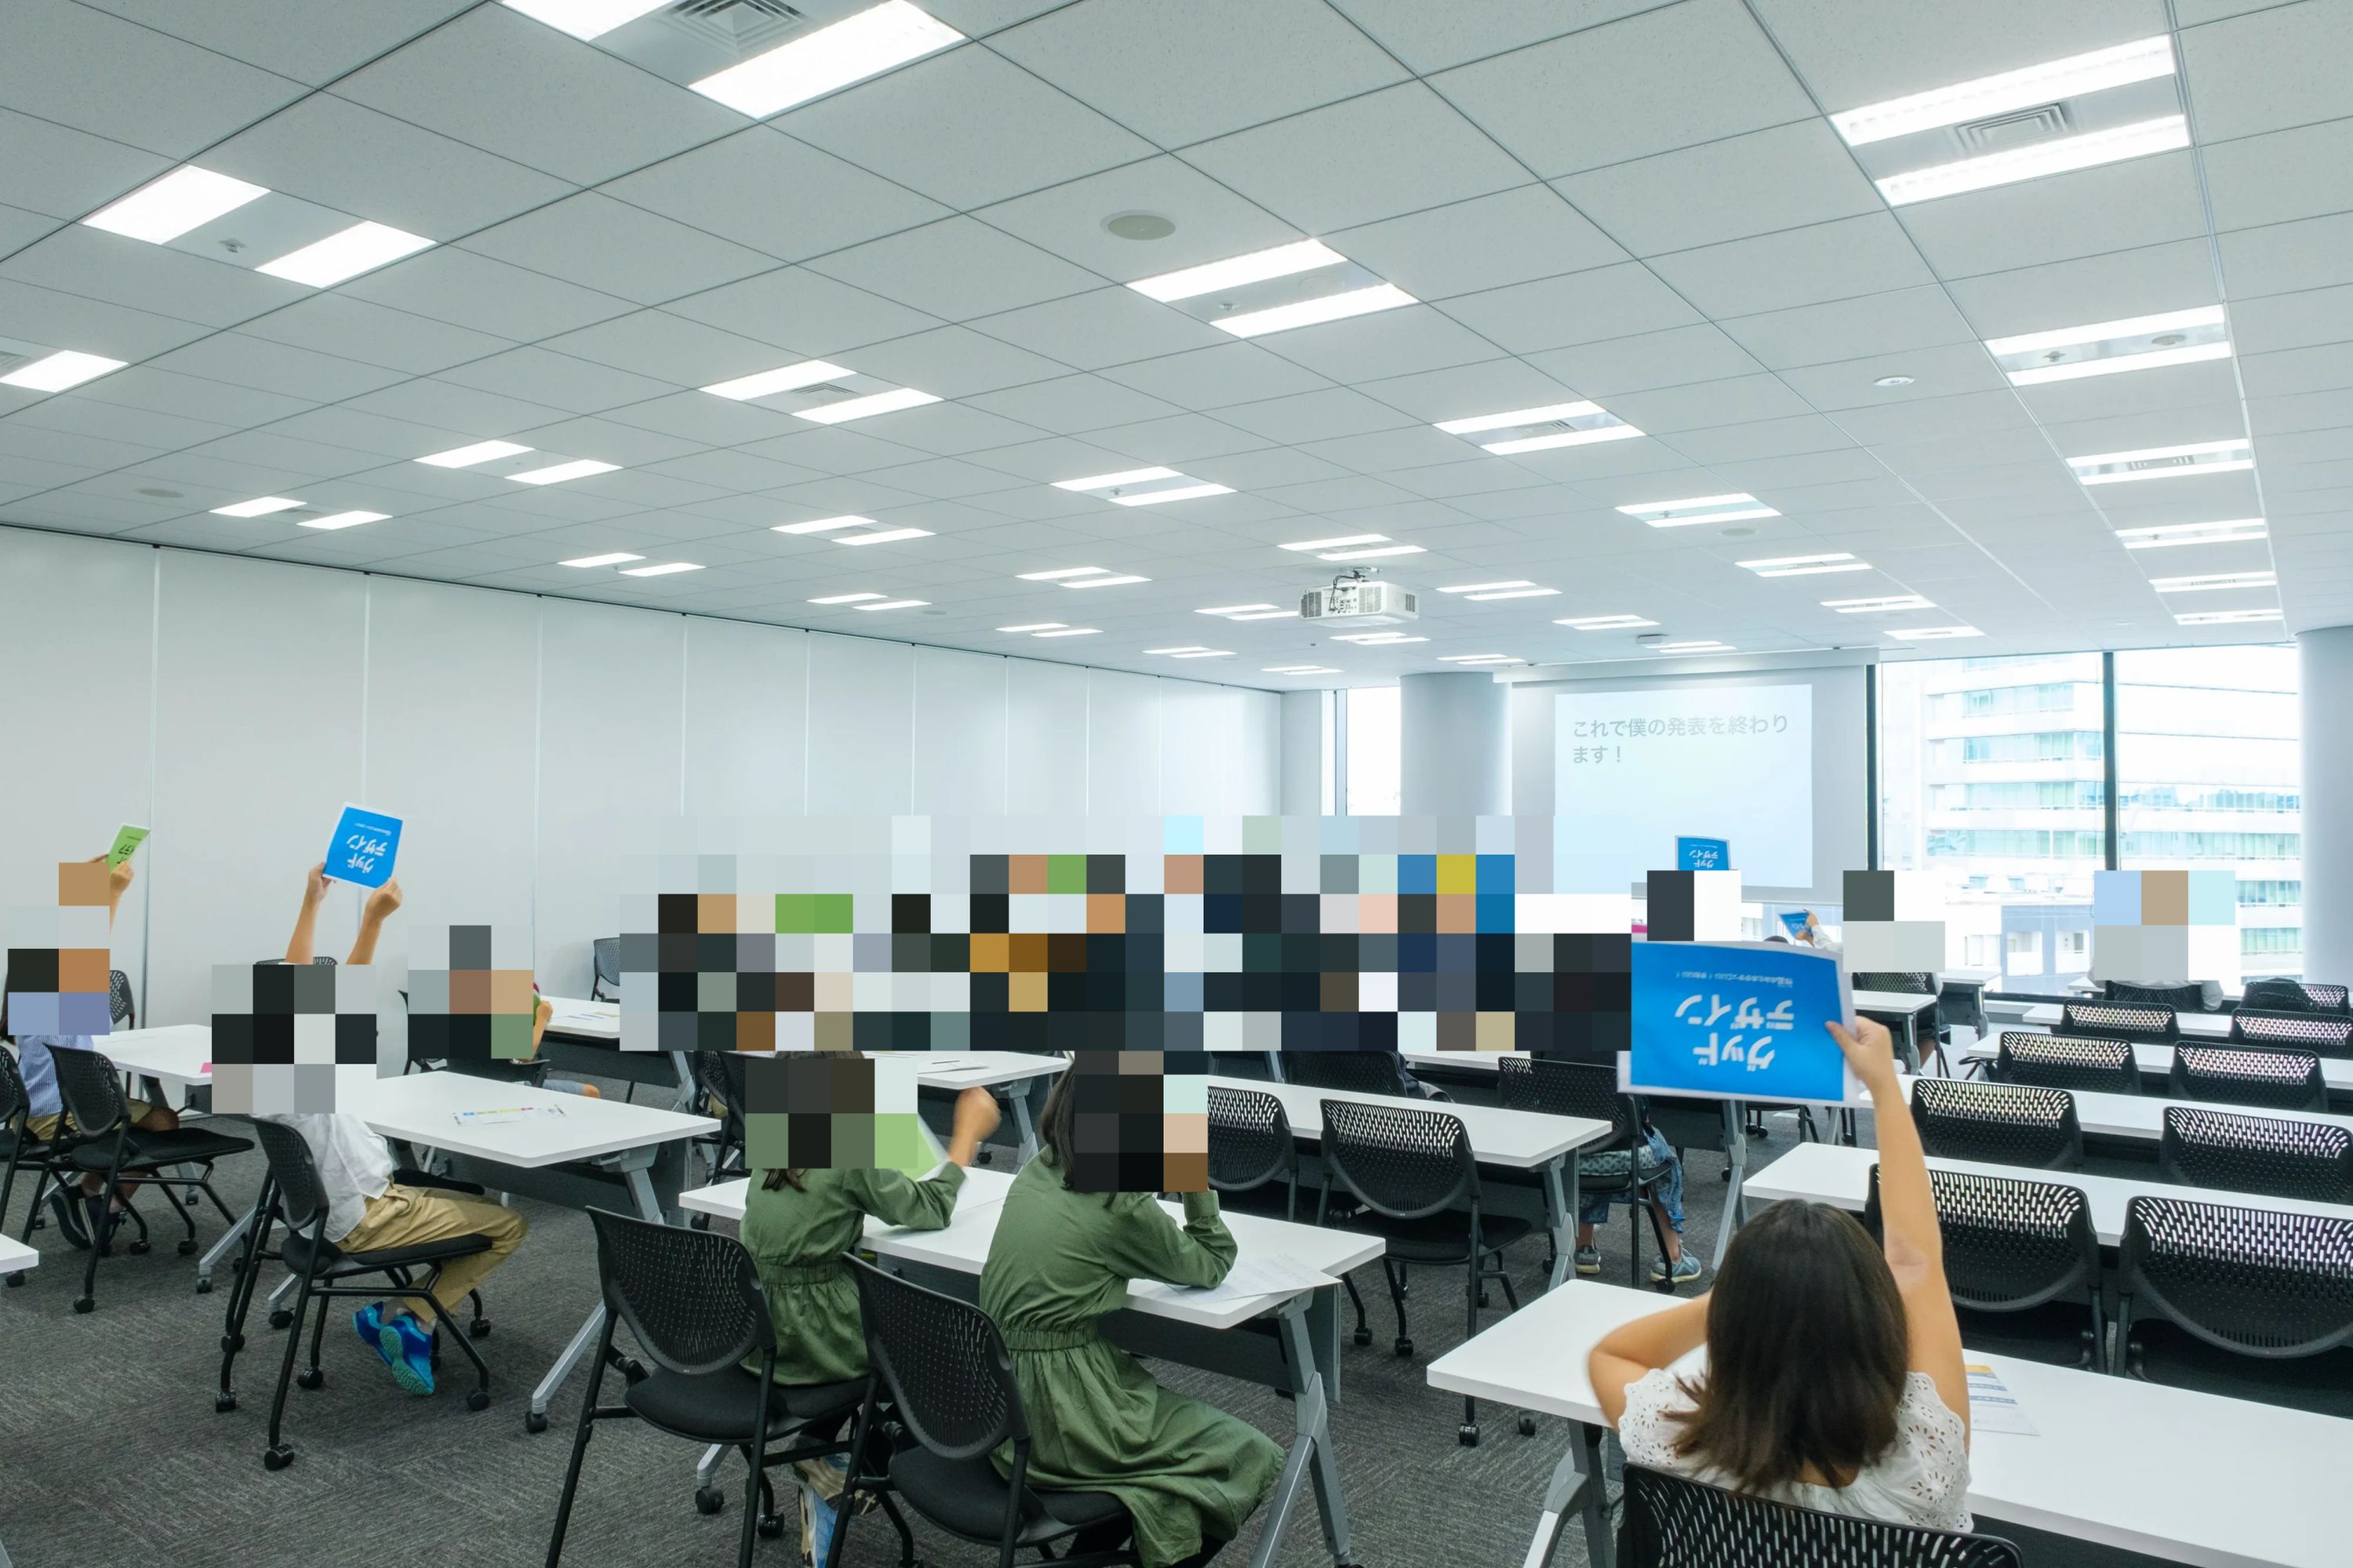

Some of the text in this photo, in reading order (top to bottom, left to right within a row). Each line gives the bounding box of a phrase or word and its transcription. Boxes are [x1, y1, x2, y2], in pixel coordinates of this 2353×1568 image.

[1573, 714, 1787, 737] これで僕の発表を終わり
[1573, 745, 1620, 763] ます！
[346, 834, 388, 857] デザイン
[1689, 849, 1718, 859] デザイン
[347, 853, 375, 874] グッド
[1693, 859, 1715, 869] グッド
[1674, 994, 1795, 1030] デザイン
[1693, 1032, 1775, 1072] グッド
